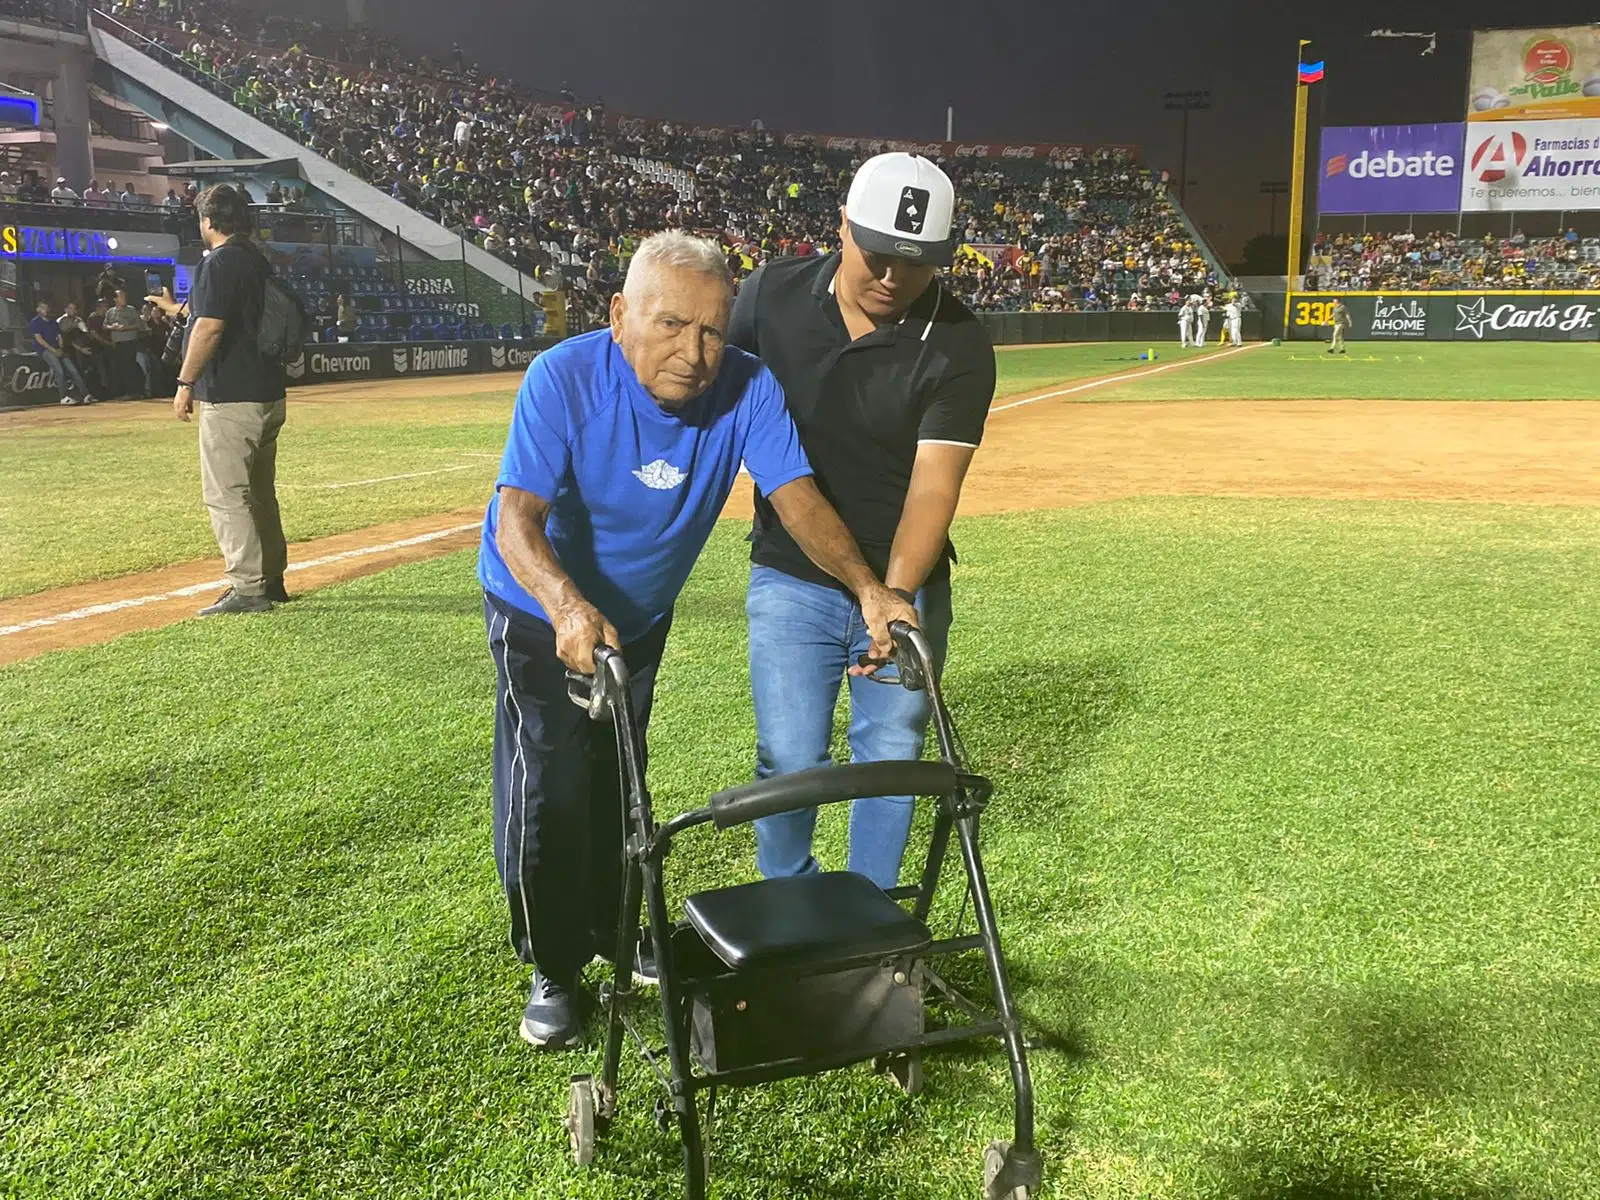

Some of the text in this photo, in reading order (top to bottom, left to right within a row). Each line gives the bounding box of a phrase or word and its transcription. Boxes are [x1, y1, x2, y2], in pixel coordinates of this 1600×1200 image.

[955, 144, 989, 158] Coca-Cola
[1002, 145, 1036, 159] Coca-Cola
[1534, 138, 1590, 151] Farmacias
[1350, 150, 1455, 179] debate
[904, 188, 914, 200] A
[1470, 187, 1484, 199] Te
[404, 278, 456, 295] ZONA
[1371, 319, 1426, 331] AHOME
[1490, 303, 1597, 332] Carl's Jr.
[310, 353, 371, 374] Chevron
[412, 345, 469, 371] Havoline
[507, 348, 542, 366] Chev
